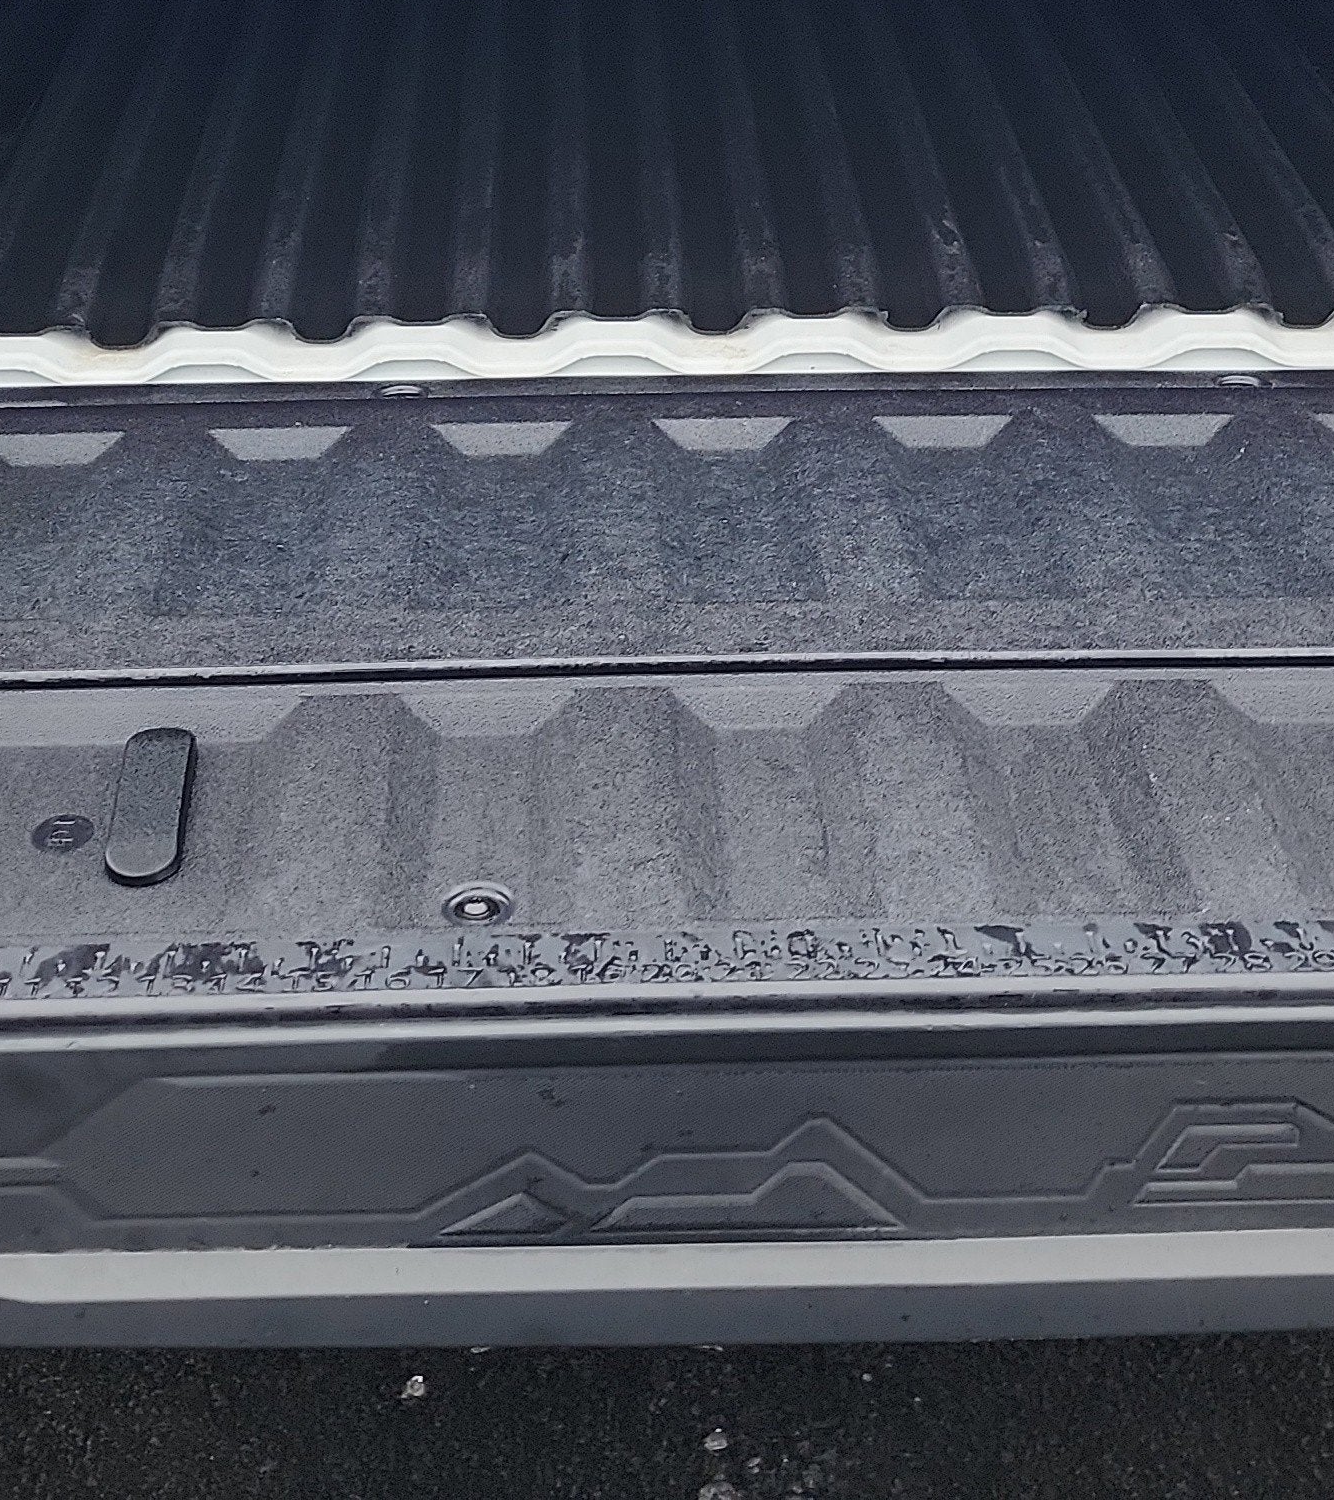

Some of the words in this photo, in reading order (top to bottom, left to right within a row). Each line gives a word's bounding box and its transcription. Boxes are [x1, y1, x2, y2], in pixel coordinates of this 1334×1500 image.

[285, 971, 338, 991] 15
[349, 969, 412, 990] 16
[424, 967, 484, 988] 17
